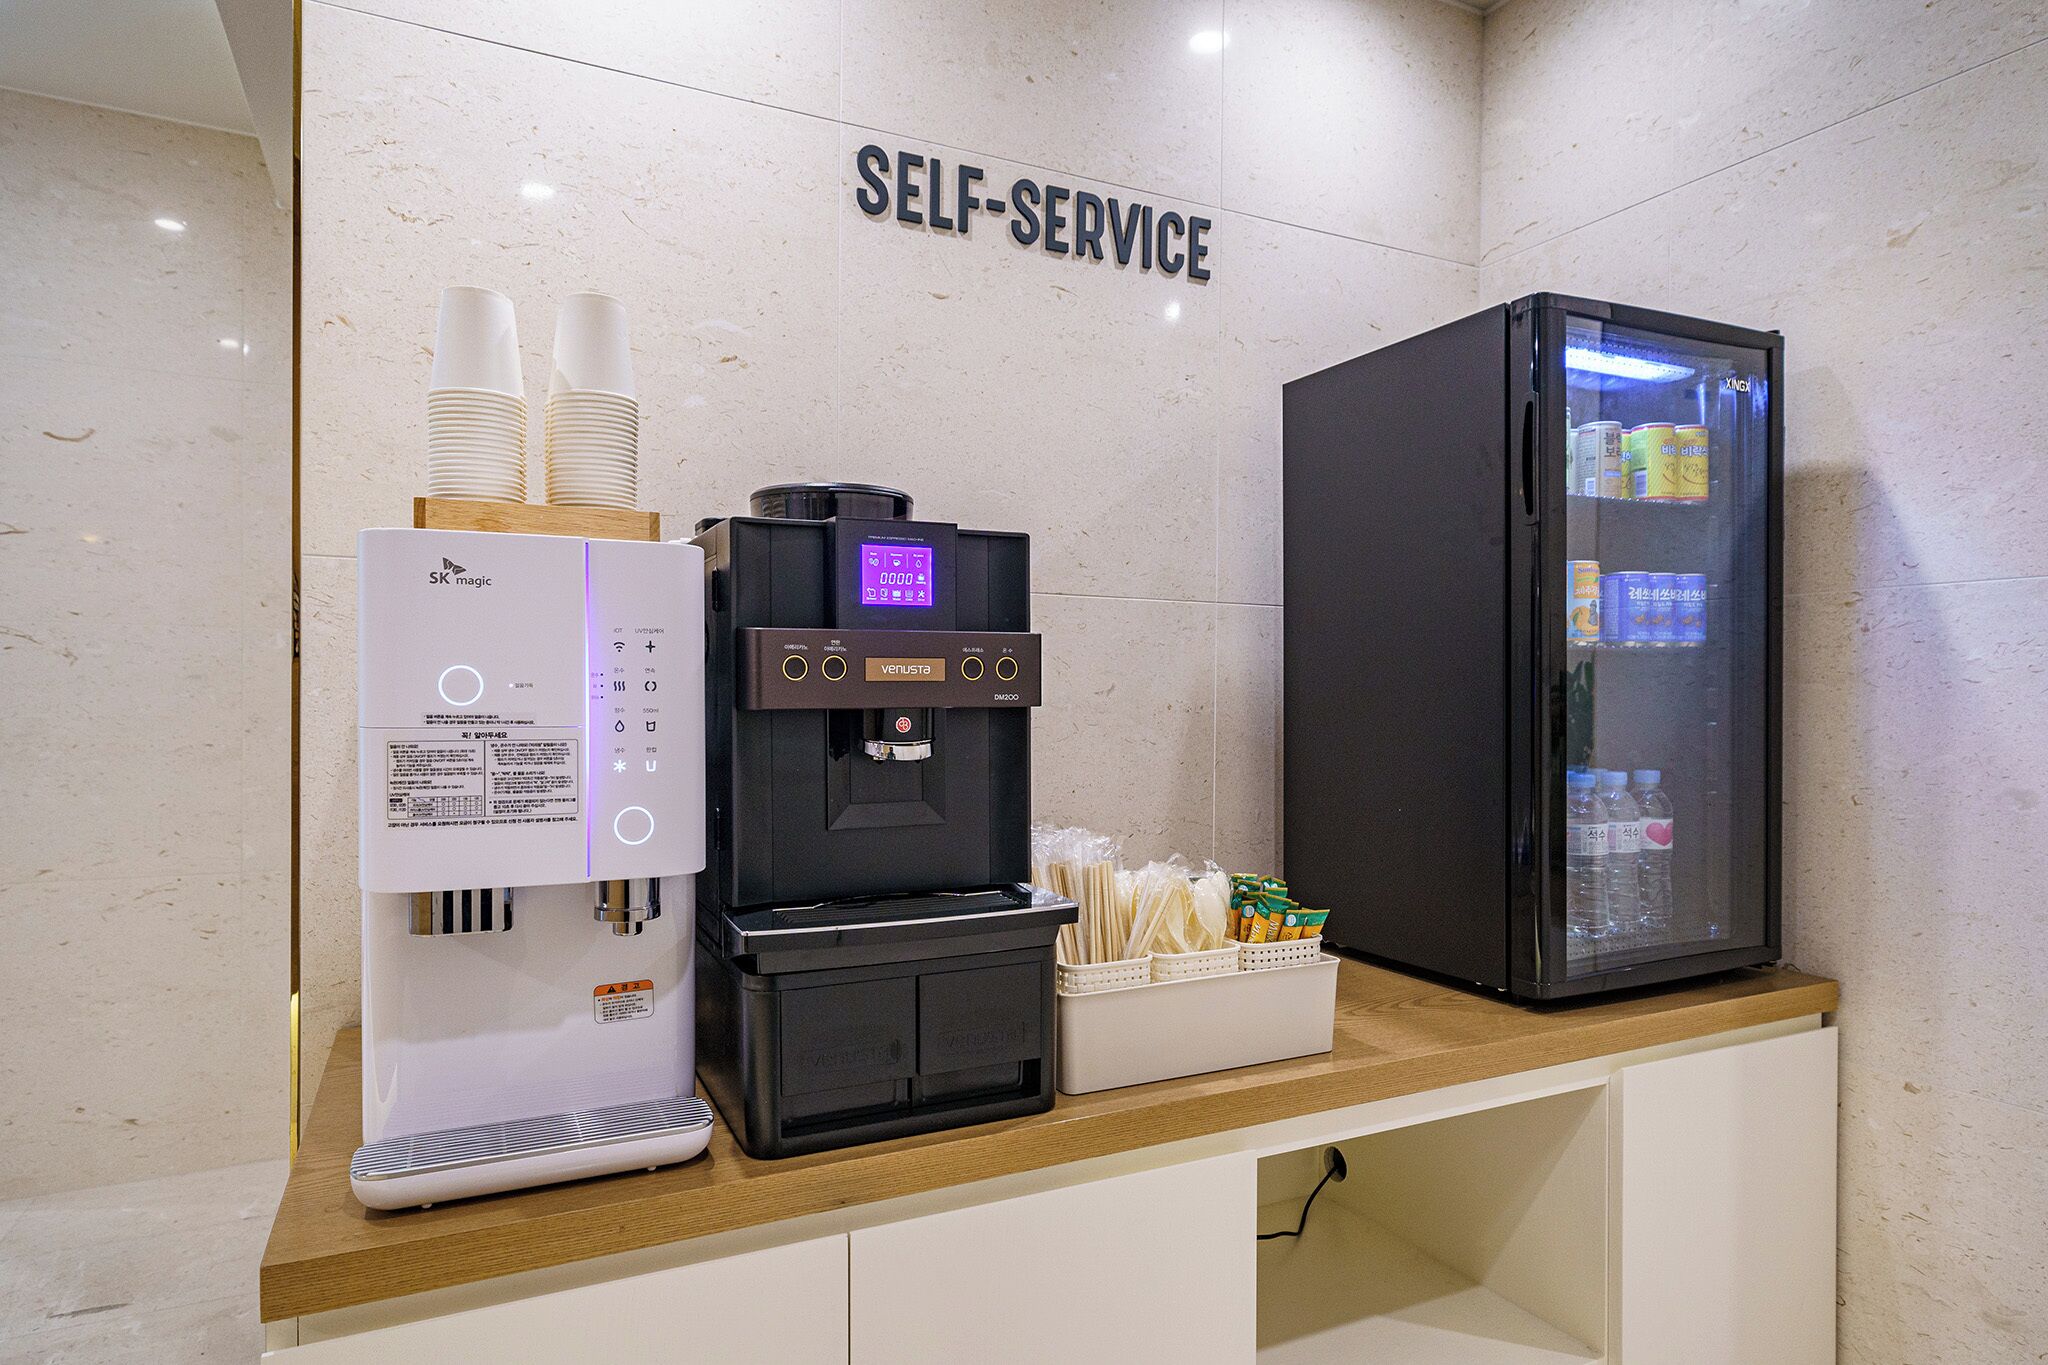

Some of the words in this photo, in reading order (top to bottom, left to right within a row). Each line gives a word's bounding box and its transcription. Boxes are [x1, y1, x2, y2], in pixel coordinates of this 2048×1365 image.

[856, 144, 1212, 280] SELF-SERVICE
[1726, 378, 1751, 392] XINGX
[429, 572, 450, 584] SK
[456, 576, 492, 588] magic
[880, 572, 913, 585] 0000
[1588, 830, 1606, 841] 석수
[1622, 828, 1639, 839] 석수
